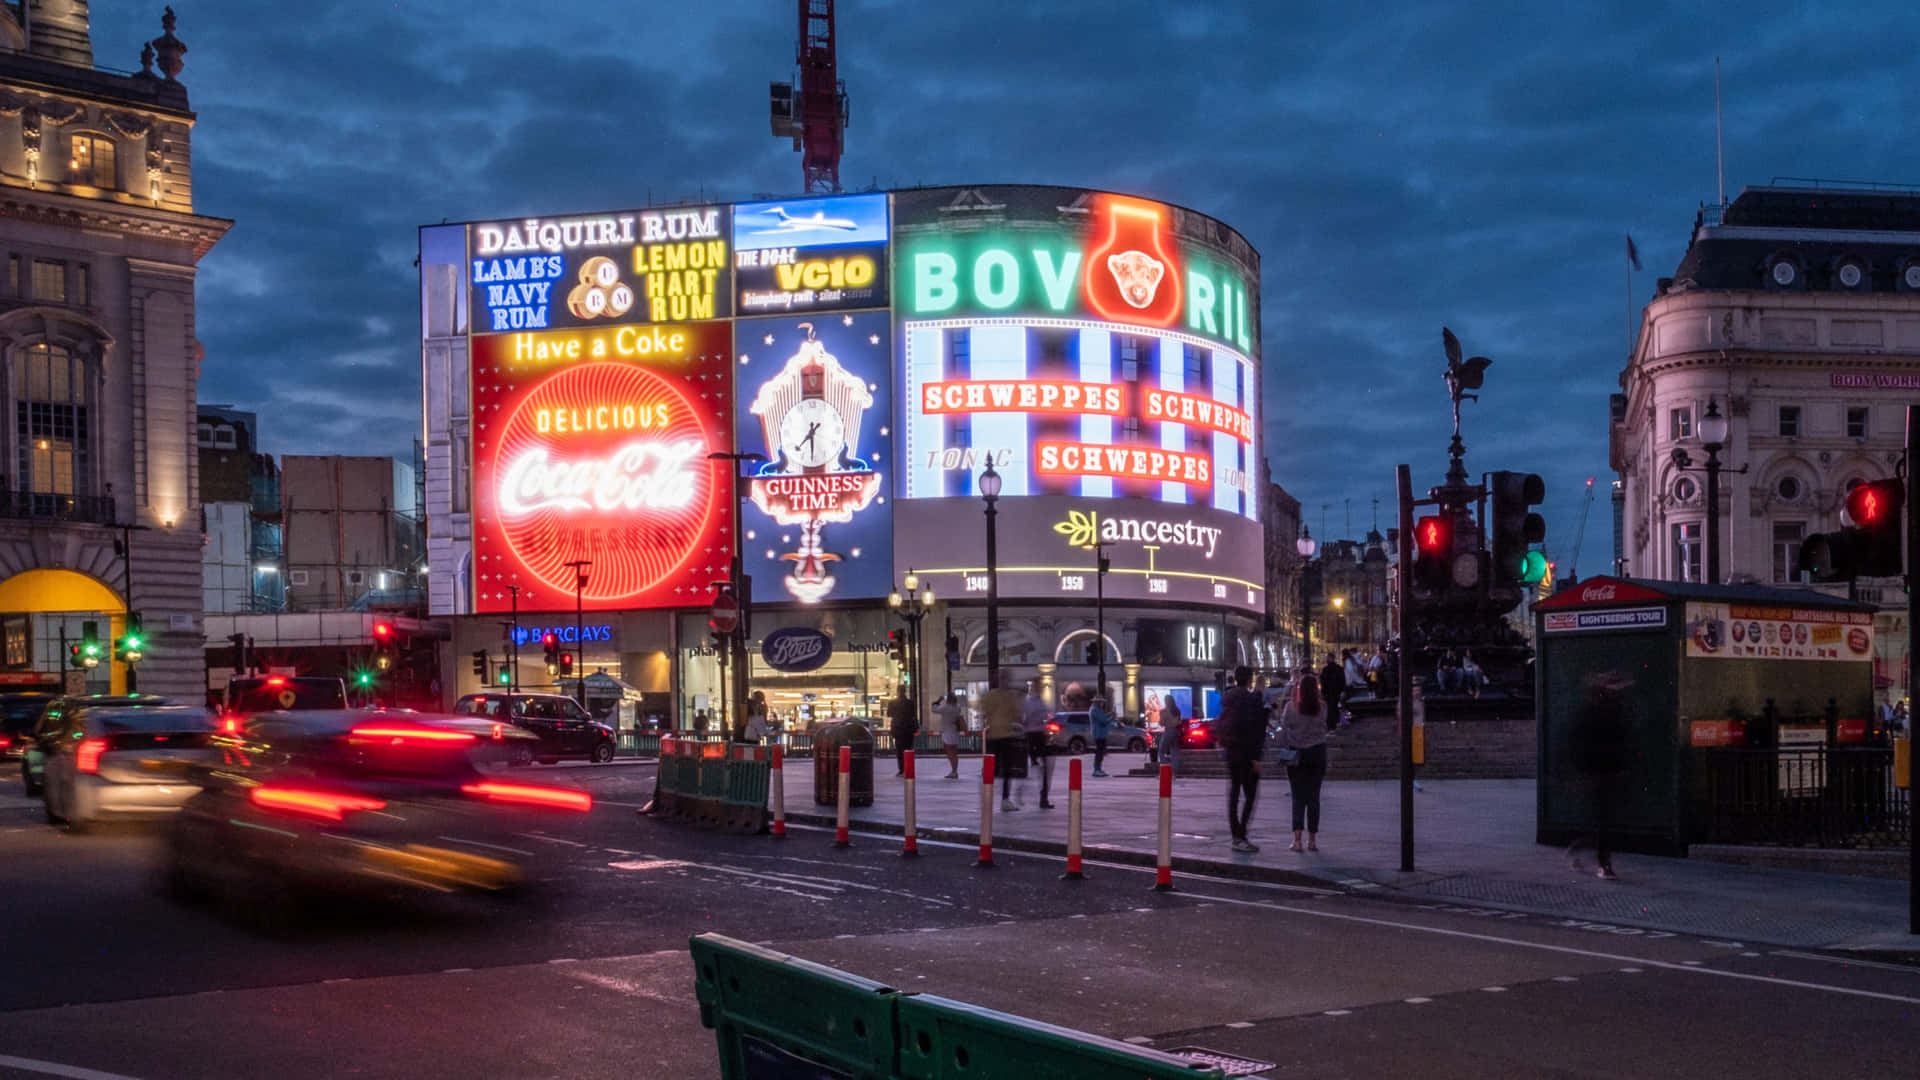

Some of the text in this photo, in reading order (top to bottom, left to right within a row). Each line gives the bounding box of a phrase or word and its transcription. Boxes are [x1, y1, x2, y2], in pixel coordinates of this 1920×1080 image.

[480, 211, 718, 253] DAÏQUIRI RUM
[473, 256, 562, 283] LAMB'S
[634, 241, 726, 272] LEMON
[737, 250, 758, 267] THE
[648, 269, 717, 297] HART
[777, 256, 875, 290] VC10
[488, 282, 550, 306] NAVY
[819, 288, 841, 301] silent
[492, 307, 547, 330] RUM
[651, 295, 714, 322] RUM
[515, 327, 684, 361] Have a Coke
[1835, 374, 1872, 385] BODY
[538, 405, 669, 433] DELICIOUS
[925, 383, 1251, 440] SCHWEPPES SCHWEPPES
[927, 448, 1013, 470] TONC
[1041, 446, 1210, 483] SCHWEPPES
[766, 475, 863, 496] GUINNESS
[790, 494, 839, 511] TIME
[1102, 517, 1221, 557] ancestry
[966, 576, 988, 591] 1940
[1580, 612, 1635, 626] SIGHTSEEING
[1637, 610, 1662, 622] TOUR
[531, 625, 611, 643] BARCLAYS
[848, 641, 891, 654] beauty
[1187, 626, 1216, 661] GAP
[769, 636, 823, 664] Boots
